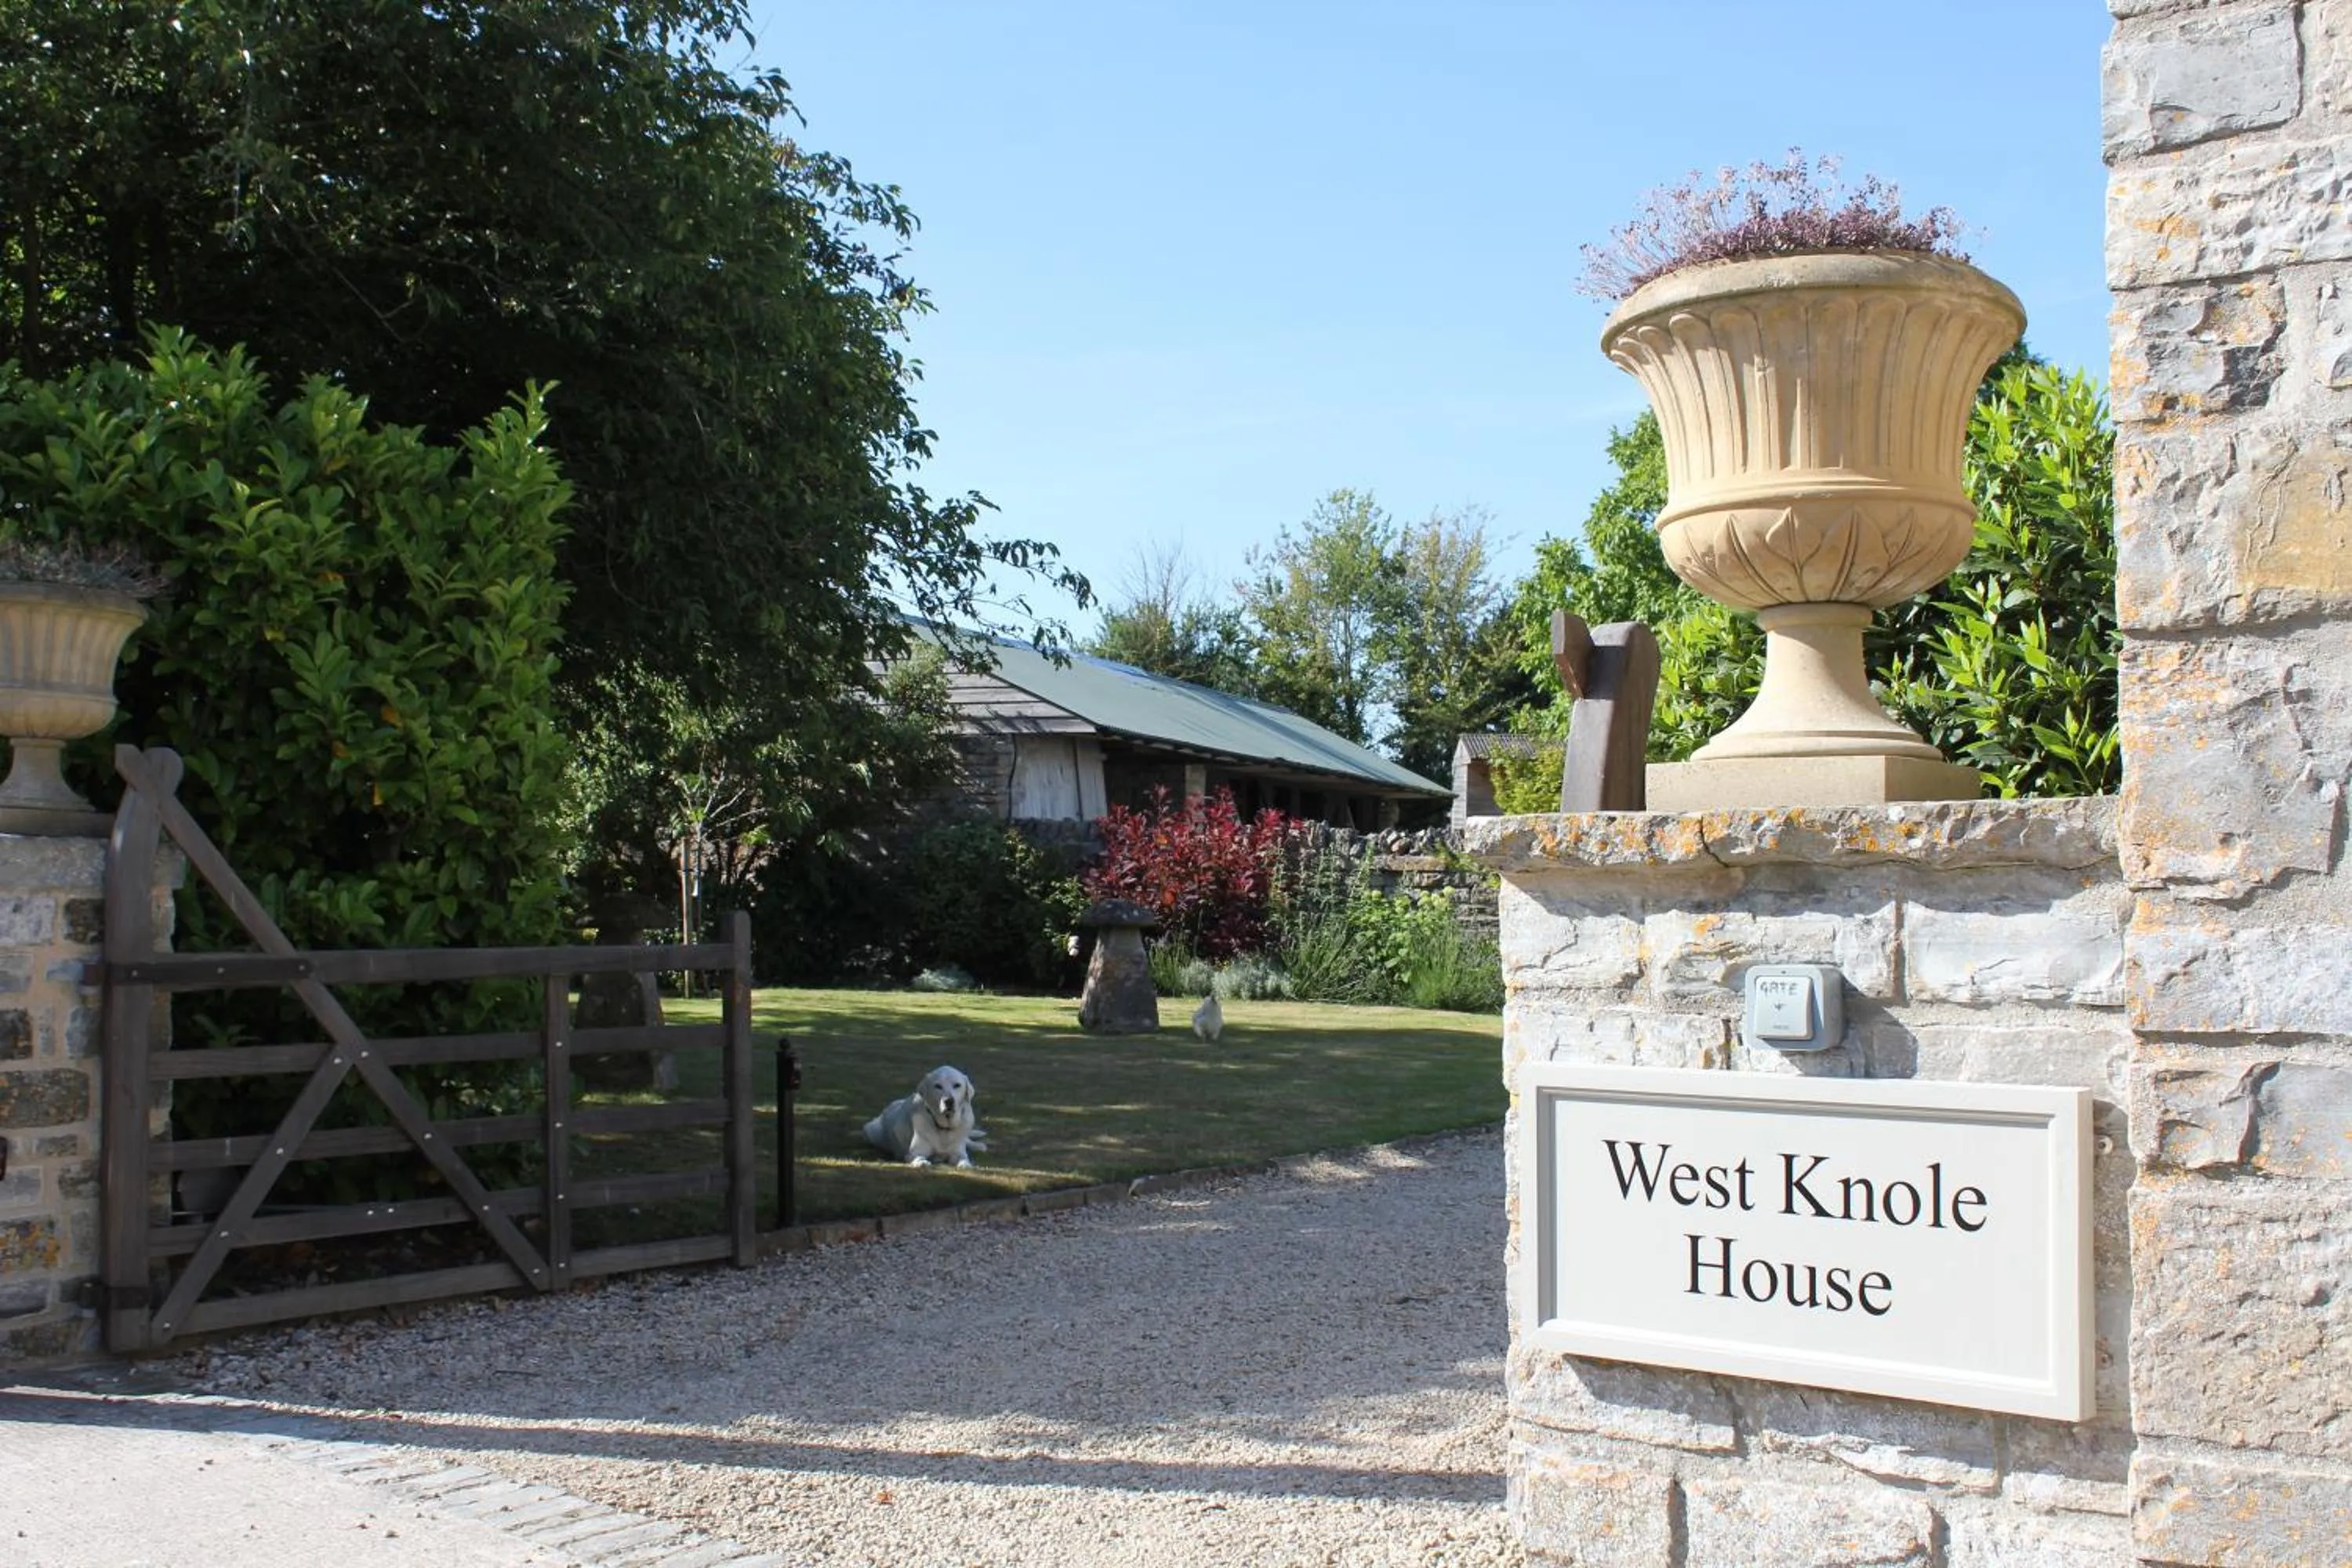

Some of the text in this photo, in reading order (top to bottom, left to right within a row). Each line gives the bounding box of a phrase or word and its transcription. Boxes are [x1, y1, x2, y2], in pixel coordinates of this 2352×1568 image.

[1759, 981, 1798, 996] GATE
[1602, 1139, 1987, 1232] West Knole
[1684, 1234, 1893, 1316] House
